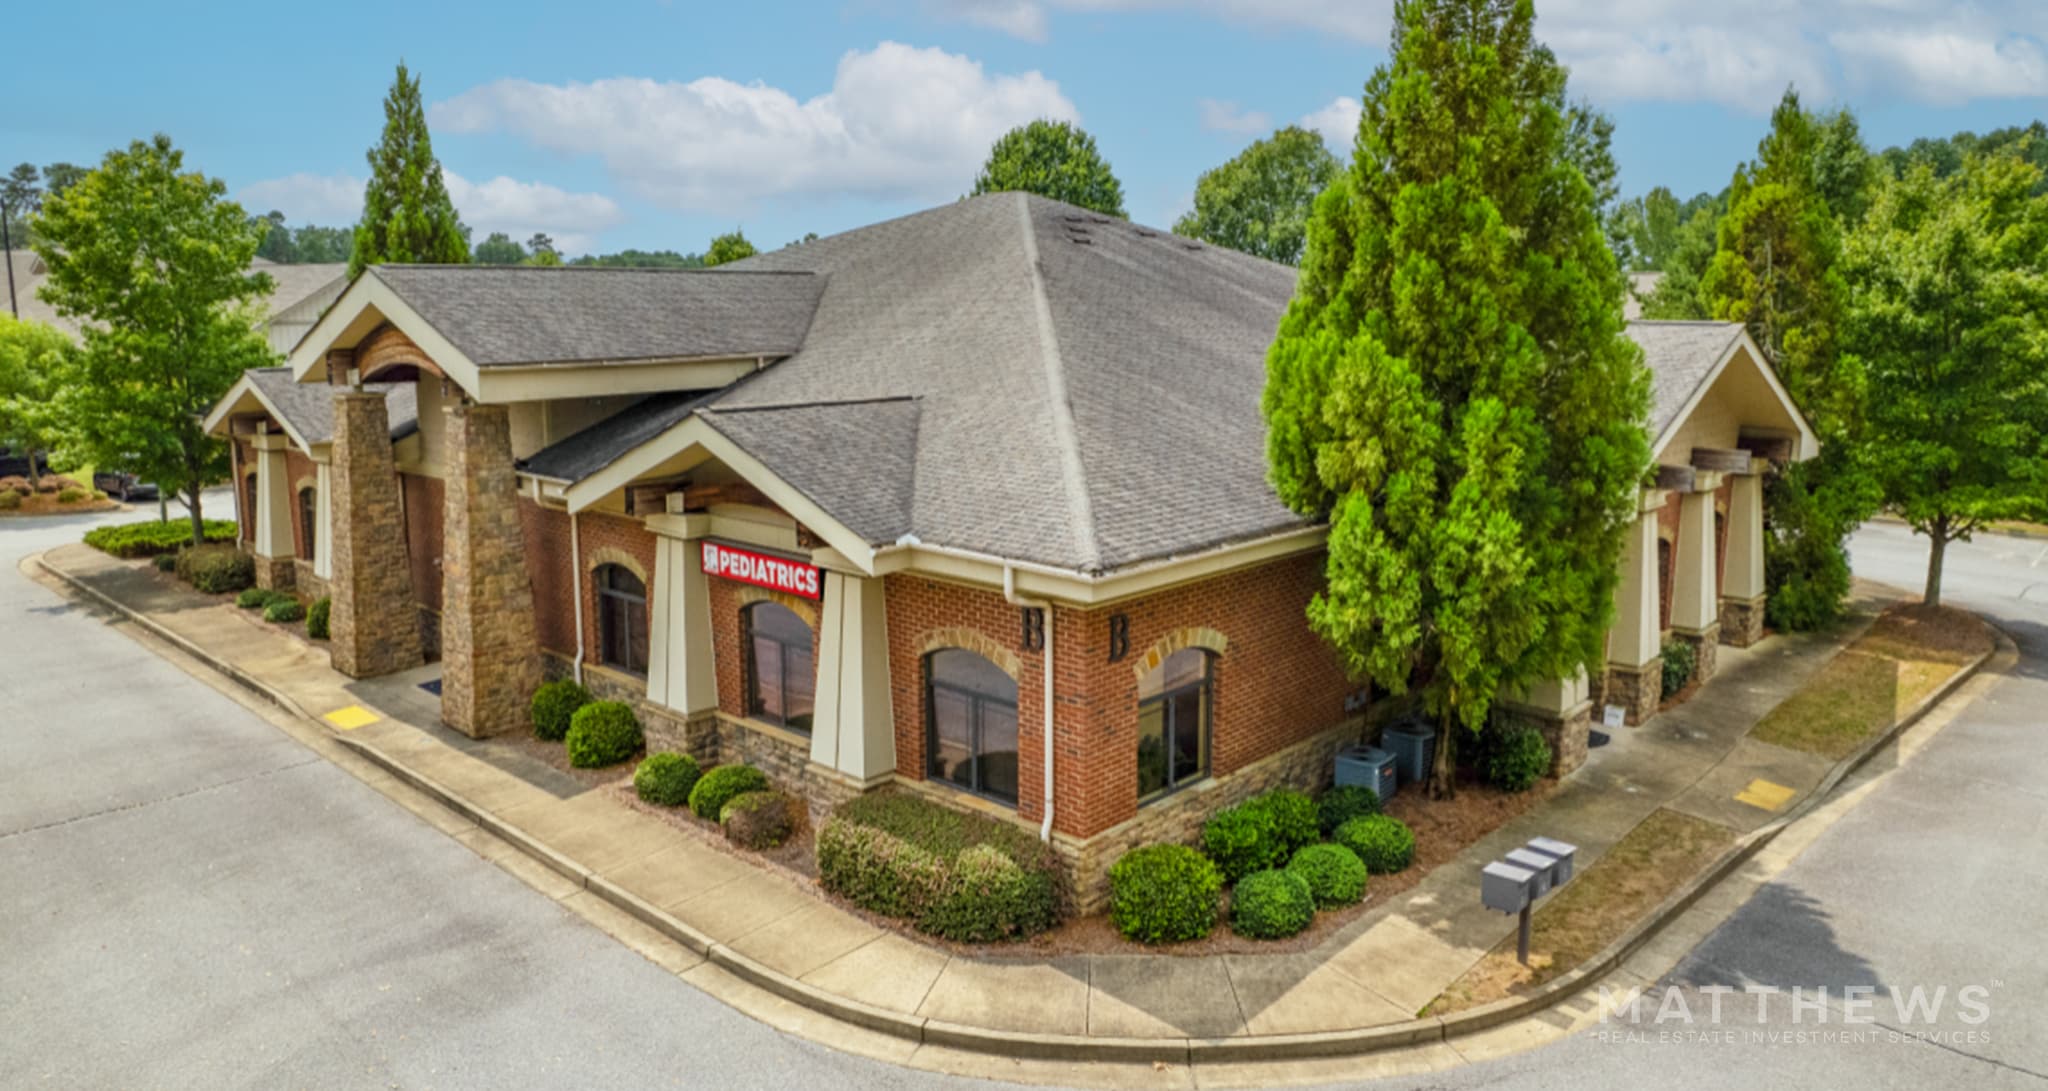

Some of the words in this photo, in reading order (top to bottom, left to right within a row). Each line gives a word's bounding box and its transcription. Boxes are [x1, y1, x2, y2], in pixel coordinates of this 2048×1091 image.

[719, 550, 818, 594] PEDIATRICS
[1022, 607, 1045, 654] B
[1108, 611, 1130, 664] B
